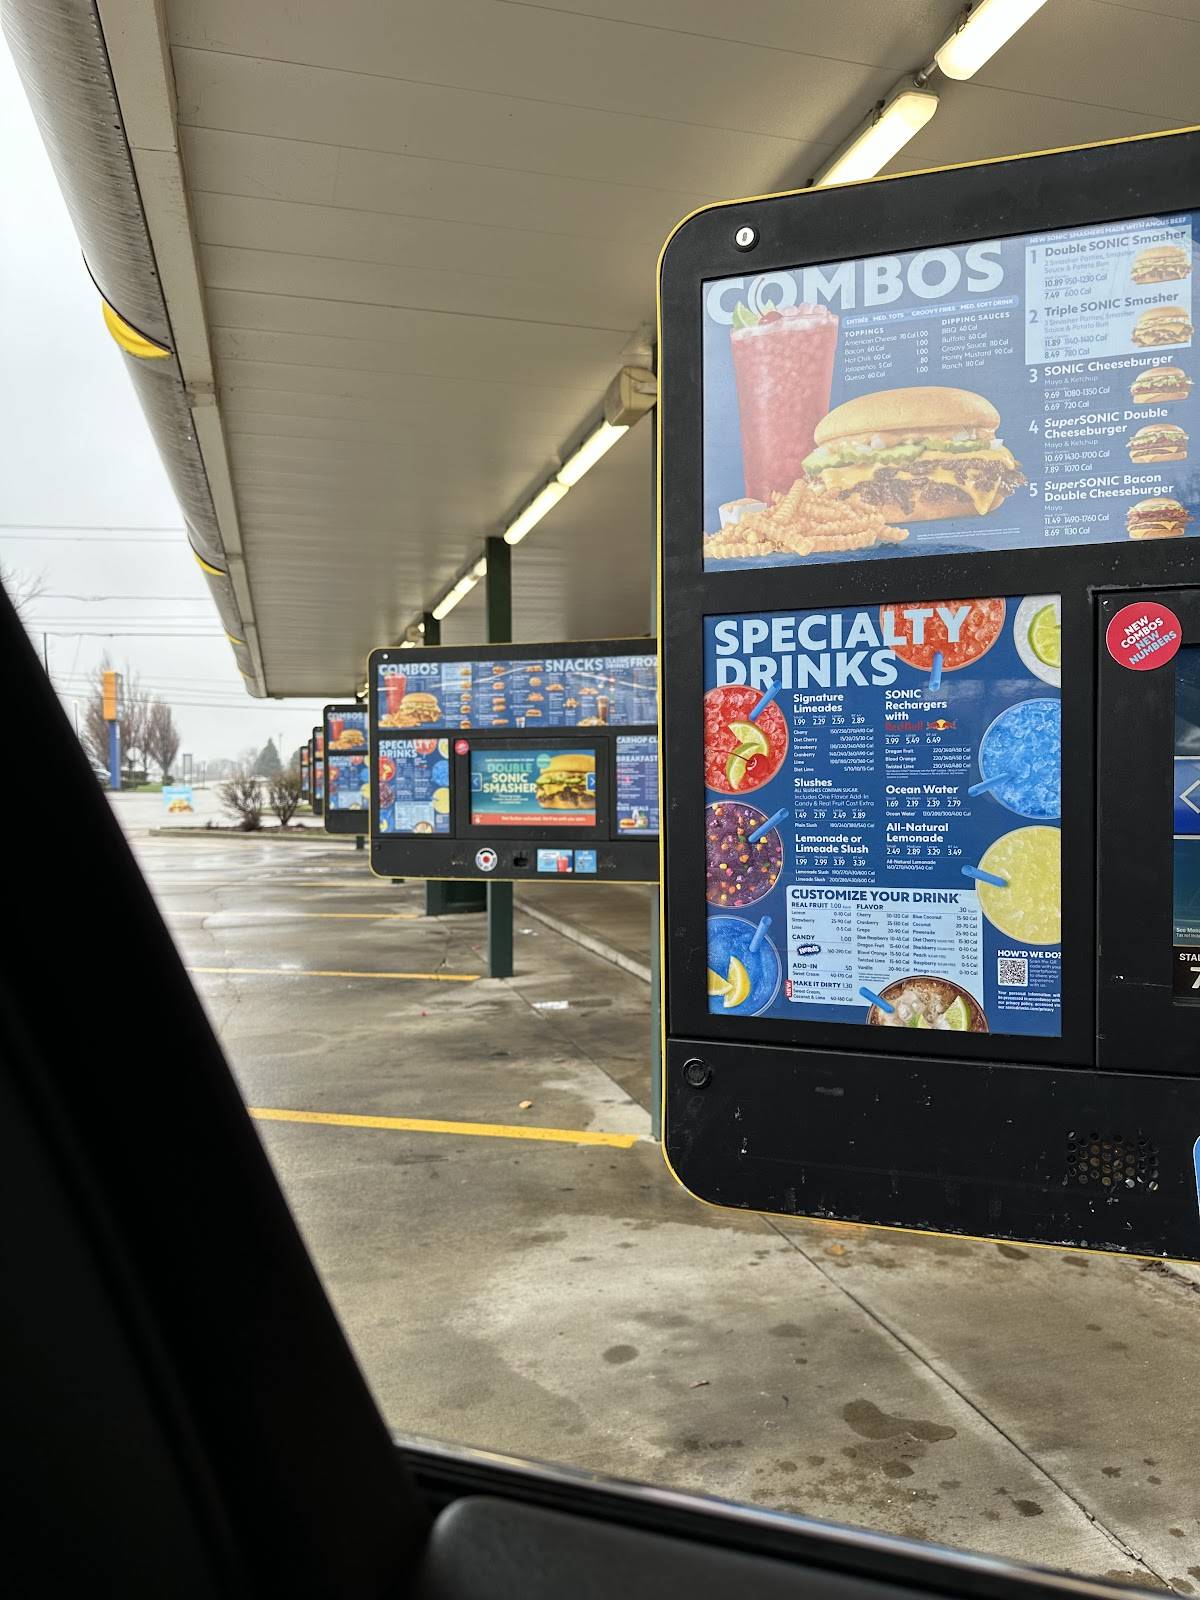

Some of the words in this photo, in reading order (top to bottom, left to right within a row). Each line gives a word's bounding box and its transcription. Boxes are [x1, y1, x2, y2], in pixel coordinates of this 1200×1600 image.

[1045, 244, 1086, 257] Double
[1089, 237, 1129, 251] SONIC
[1133, 230, 1186, 245] Smasher
[1030, 250, 1037, 264] 1
[706, 243, 1004, 325] COMBOS
[1045, 279, 1063, 287] 10.89
[1045, 304, 1078, 317] Triple
[1081, 298, 1121, 312] SONIC
[1125, 292, 1179, 307] Smasher
[942, 316, 975, 325] DIPPING
[978, 312, 1010, 320] SAUCES
[1029, 309, 1038, 323] 2
[845, 328, 884, 337] TOPPINGS
[942, 326, 956, 334] BBQ
[845, 337, 874, 346] American
[875, 335, 897, 343] Cheese
[942, 335, 966, 343] Buffalo
[1045, 339, 1061, 347] 11.89
[845, 347, 864, 356] Bacon
[942, 345, 965, 353] Groovy
[942, 353, 963, 362] Honey
[965, 349, 992, 358] Mustard
[1045, 351, 1059, 359] 8.49
[942, 361, 963, 370] Ranch
[1045, 363, 1084, 376] SONIC
[1088, 355, 1173, 372] Cheeseburger
[845, 373, 865, 382] Queso
[1029, 368, 1038, 382] 3
[1045, 379, 1063, 387] Mayo
[1071, 375, 1098, 384] Ketchup
[1045, 391, 1059, 400] 9.69
[1045, 403, 1059, 411] 6.69
[1045, 411, 1120, 429] SuperSONIC
[1124, 408, 1168, 420] Double
[1029, 420, 1038, 434] 4
[1045, 424, 1128, 439] Cheeseburger
[1045, 454, 1063, 462] 10.69
[1045, 465, 1059, 473] 7.89
[1045, 475, 1120, 492] SuperSONIC
[1124, 474, 1161, 485] Bacon
[1030, 483, 1038, 497] 5
[1045, 488, 1087, 502] Double
[1090, 484, 1174, 499] Cheeseburger
[1045, 517, 1061, 525] 11.49
[1045, 529, 1059, 537] 8.69
[1124, 616, 1148, 635] NEW
[714, 606, 972, 656] SPECIALTY
[1121, 618, 1163, 648] COMBOS
[1135, 630, 1159, 650] NEW
[1129, 630, 1176, 665] NUMBERS
[379, 663, 438, 676] COMBOS
[545, 659, 603, 672] SNACKS
[716, 649, 899, 690] DRINKS
[793, 693, 844, 704] Signature
[885, 689, 922, 699] SONIC
[794, 704, 843, 713] Limeades
[886, 701, 947, 711] Rechargers
[885, 712, 909, 720] with
[379, 740, 431, 749] SPECIALTY
[379, 749, 417, 758] DRINKS
[487, 763, 533, 773] DOUBLE
[492, 773, 528, 783] SONIC
[795, 778, 832, 787] Slushes
[483, 783, 537, 793] SMASHER
[886, 785, 920, 794] Ocean
[923, 785, 958, 794] Water
[886, 823, 948, 832] All-Natural
[795, 834, 848, 843] Lemonade
[887, 833, 944, 842] Lemonade
[796, 844, 839, 853] Limeade
[841, 845, 869, 853] Slush
[792, 889, 867, 900] CUSTOMIZE
[870, 891, 910, 902] YOUR
